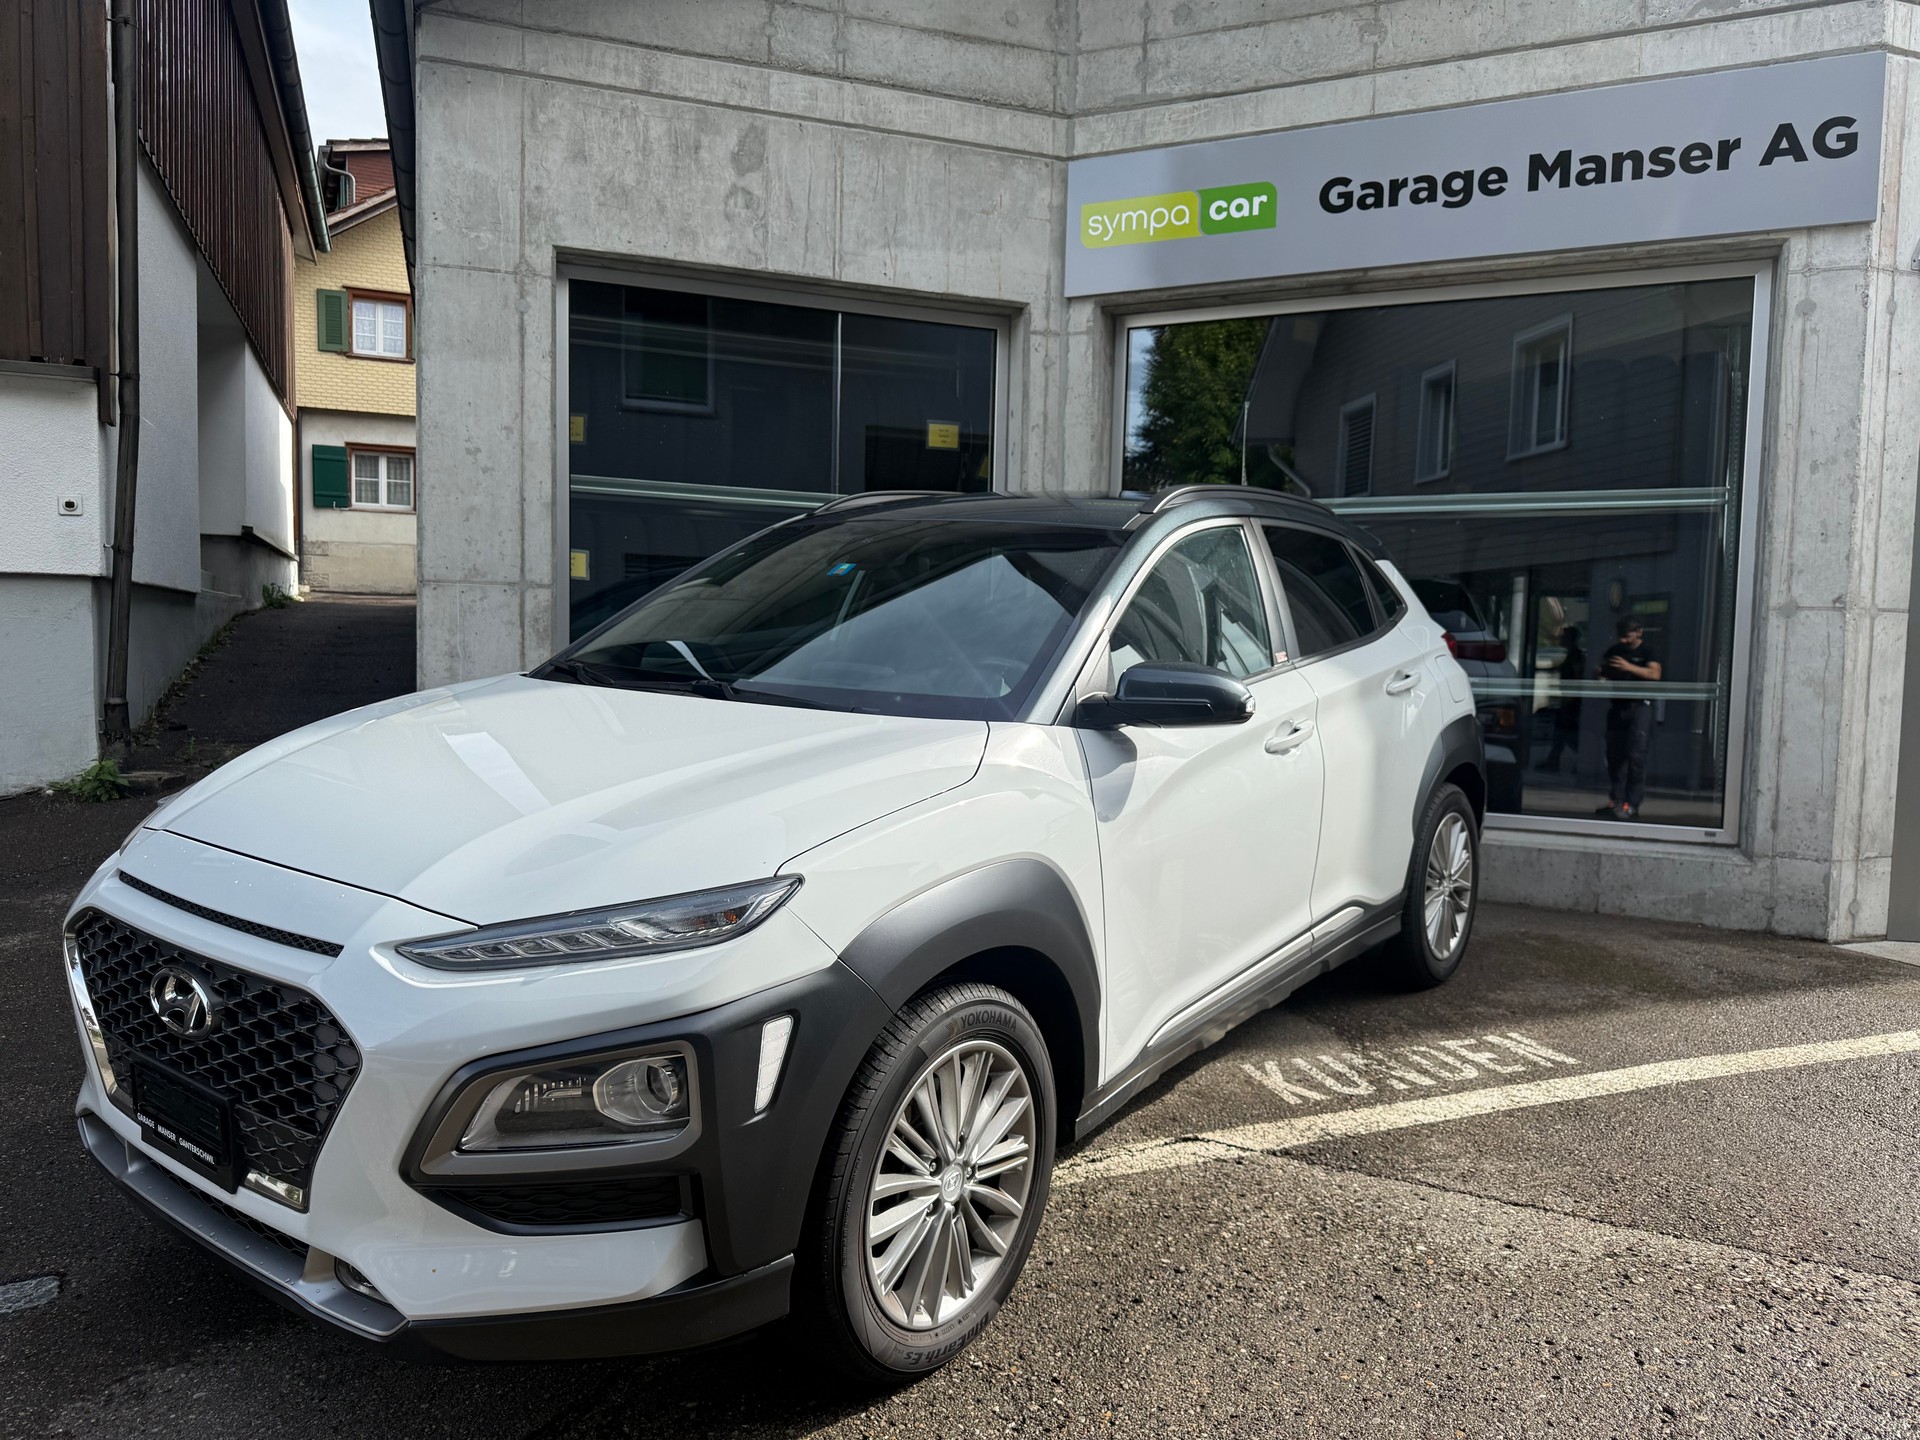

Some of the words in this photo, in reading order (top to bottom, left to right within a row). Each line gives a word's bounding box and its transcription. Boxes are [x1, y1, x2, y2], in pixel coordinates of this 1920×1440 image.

[1319, 166, 1508, 214] Garage
[1528, 137, 1742, 192] Manser
[1758, 115, 1859, 167] AG
[1088, 204, 1190, 241] sympa
[1208, 194, 1268, 221] car
[960, 1009, 1017, 1032] YOKOHAMA
[137, 1112, 155, 1129] GARAGE
[157, 1124, 177, 1142] MANSER
